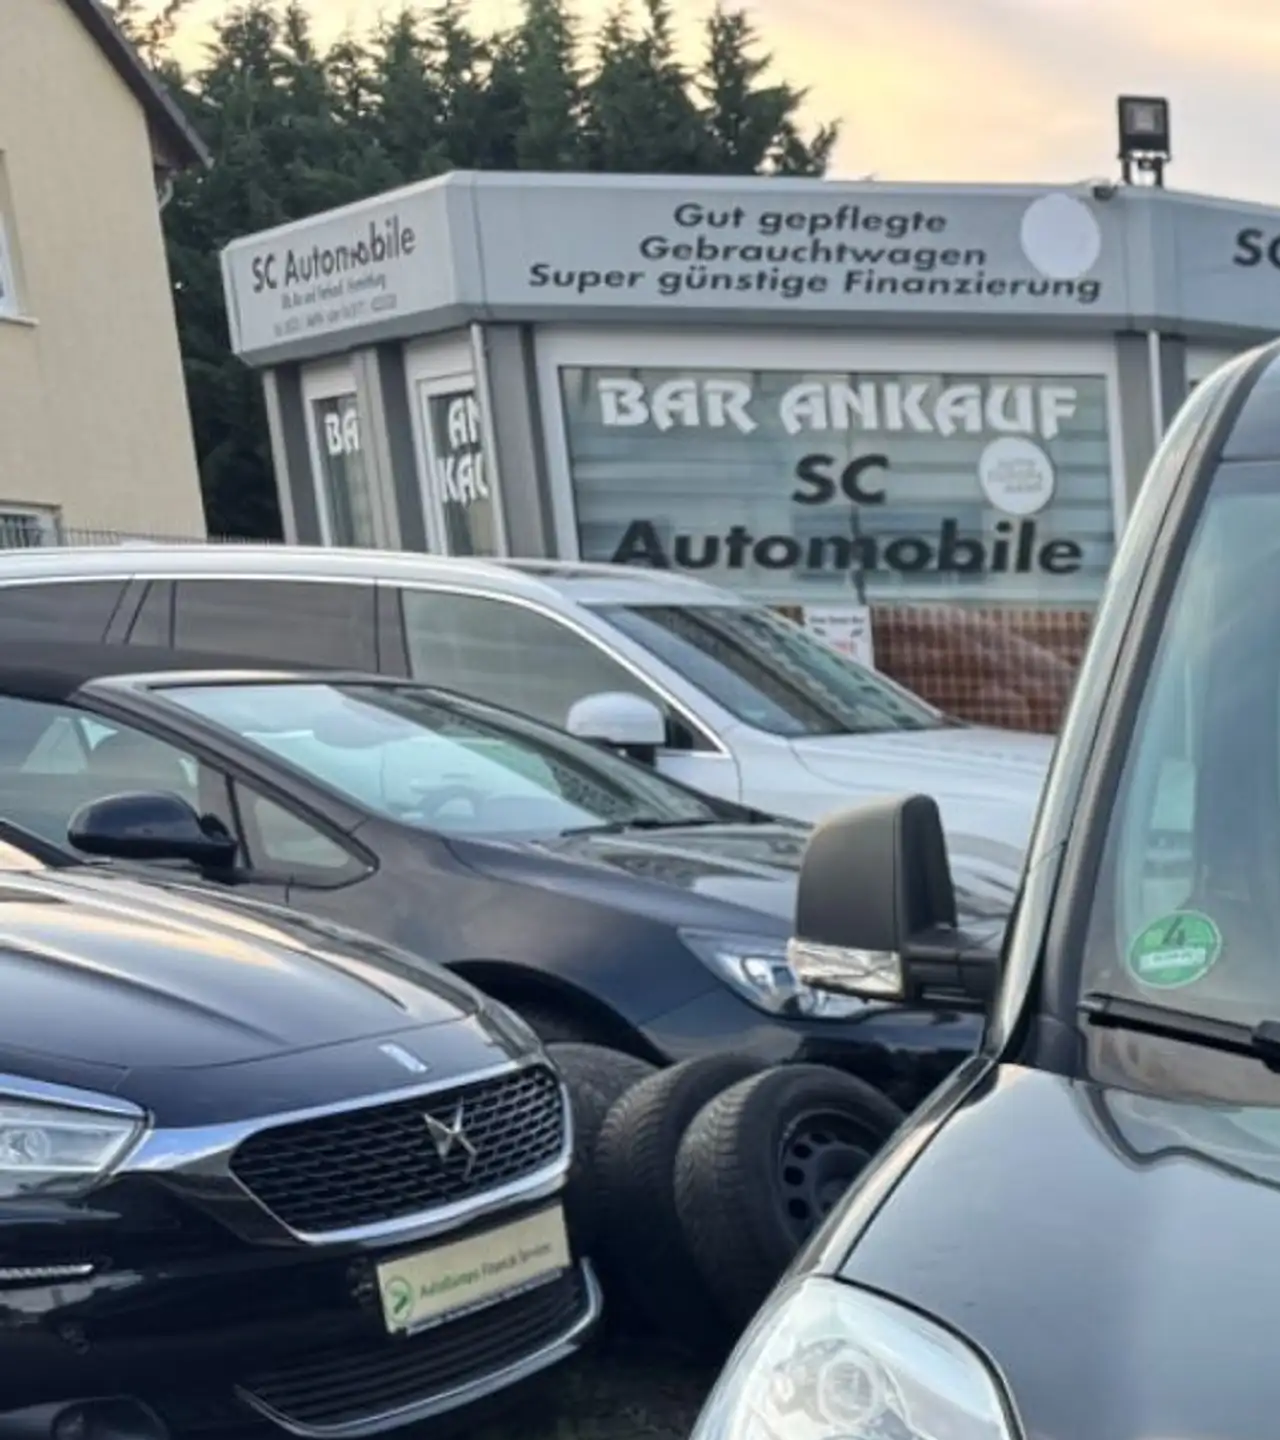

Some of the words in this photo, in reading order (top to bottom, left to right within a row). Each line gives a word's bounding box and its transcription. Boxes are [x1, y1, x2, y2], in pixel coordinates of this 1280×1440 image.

[674, 203, 745, 229] Gut
[758, 204, 948, 238] gepflegte
[252, 253, 277, 293] SC
[285, 214, 416, 286] Automobile
[639, 236, 986, 269] Gebrauchtwagen
[529, 263, 644, 295] Super
[658, 265, 827, 299] günstige
[844, 271, 1101, 303] Finanzierung
[599, 378, 756, 433] BAR
[780, 382, 1076, 440] ANKAUF
[792, 453, 889, 505] SC
[609, 517, 1082, 575] Automobile
[1161, 916, 1186, 946] 4
